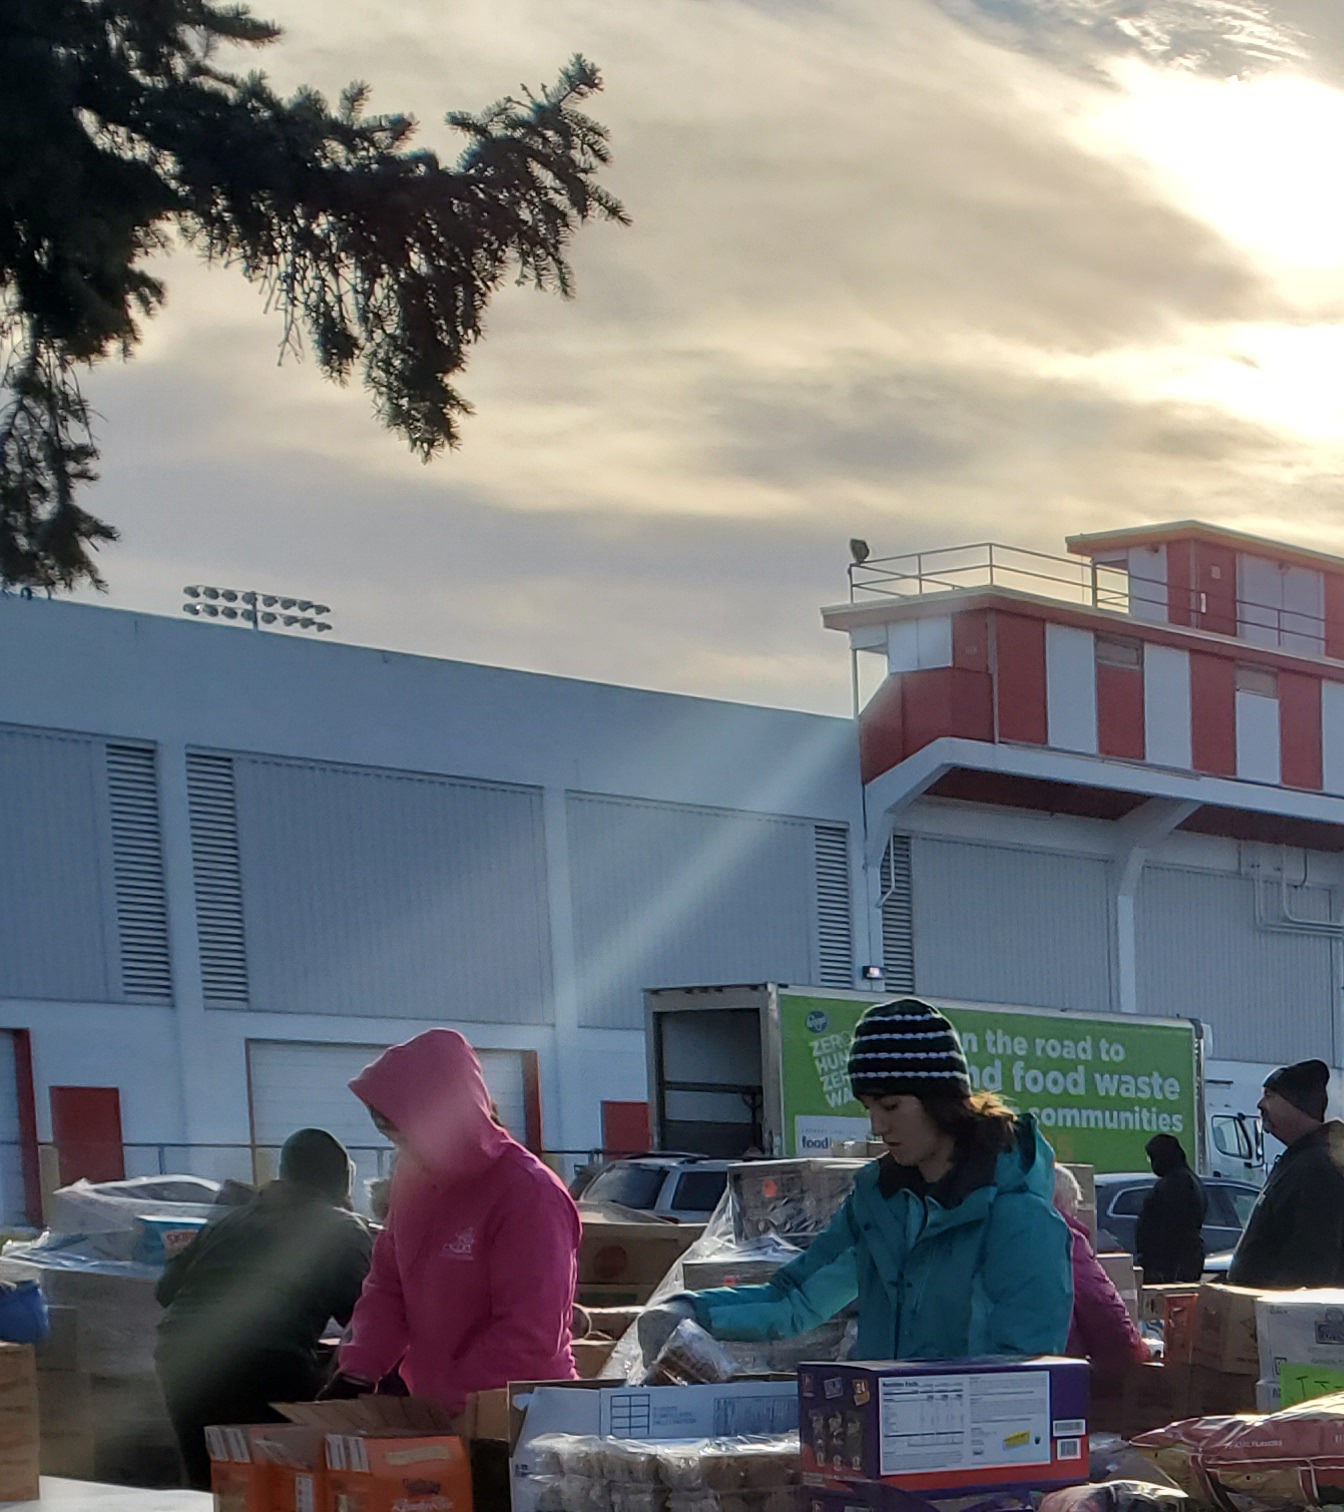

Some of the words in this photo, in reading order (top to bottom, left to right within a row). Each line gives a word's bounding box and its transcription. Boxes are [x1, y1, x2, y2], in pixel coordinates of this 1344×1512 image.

[962, 1031, 977, 1053] n
[985, 1029, 1028, 1055] the
[1035, 1035, 1092, 1061] road
[1100, 1039, 1126, 1063] to
[816, 1050, 849, 1075] HUN
[820, 1070, 850, 1092] ZER
[970, 1060, 1003, 1091] nd
[1012, 1061, 1086, 1096] food
[1094, 1071, 1180, 1100] waste
[802, 1135, 829, 1149] food
